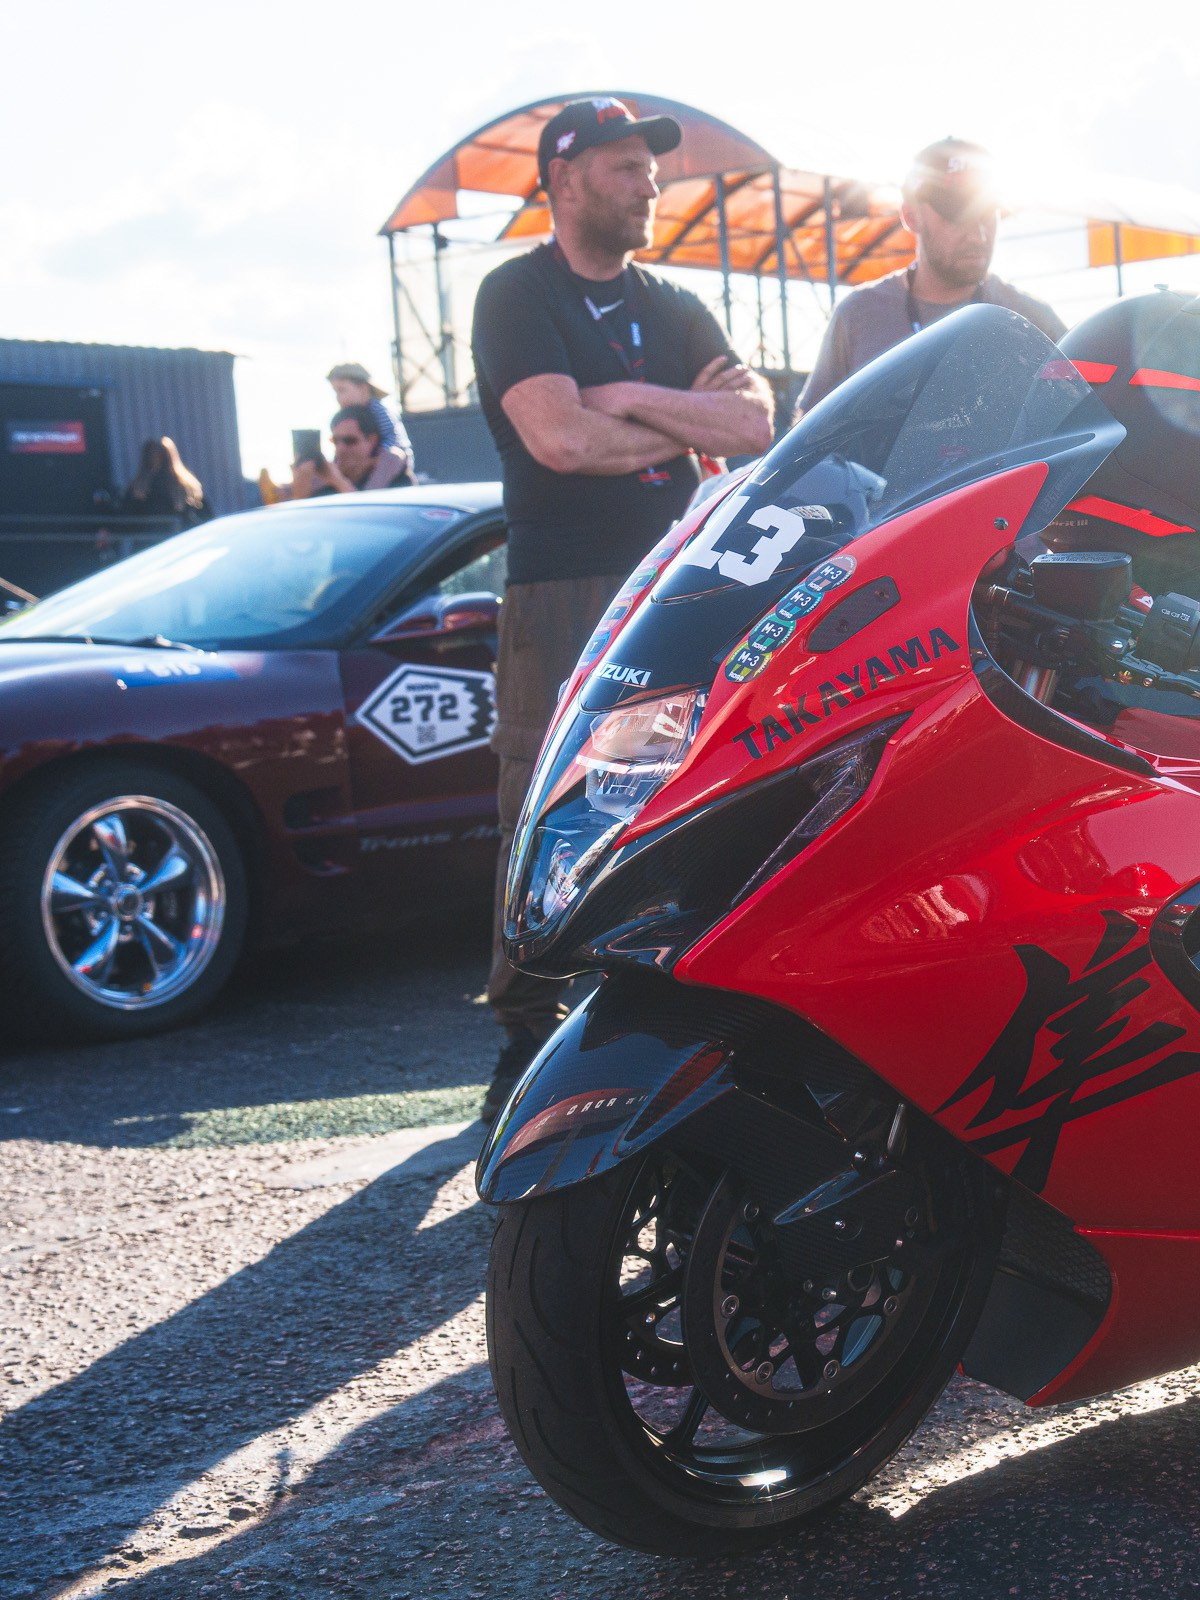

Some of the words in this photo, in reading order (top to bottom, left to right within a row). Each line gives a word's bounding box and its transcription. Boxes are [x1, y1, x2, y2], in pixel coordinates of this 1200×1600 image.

[682, 496, 806, 586] 13
[819, 565, 842, 580] M-3
[790, 591, 812, 606] M-3
[761, 622, 783, 637] M-3
[737, 650, 760, 667] M-3
[732, 627, 960, 760] TAKAYAMA
[391, 693, 460, 724] 272
